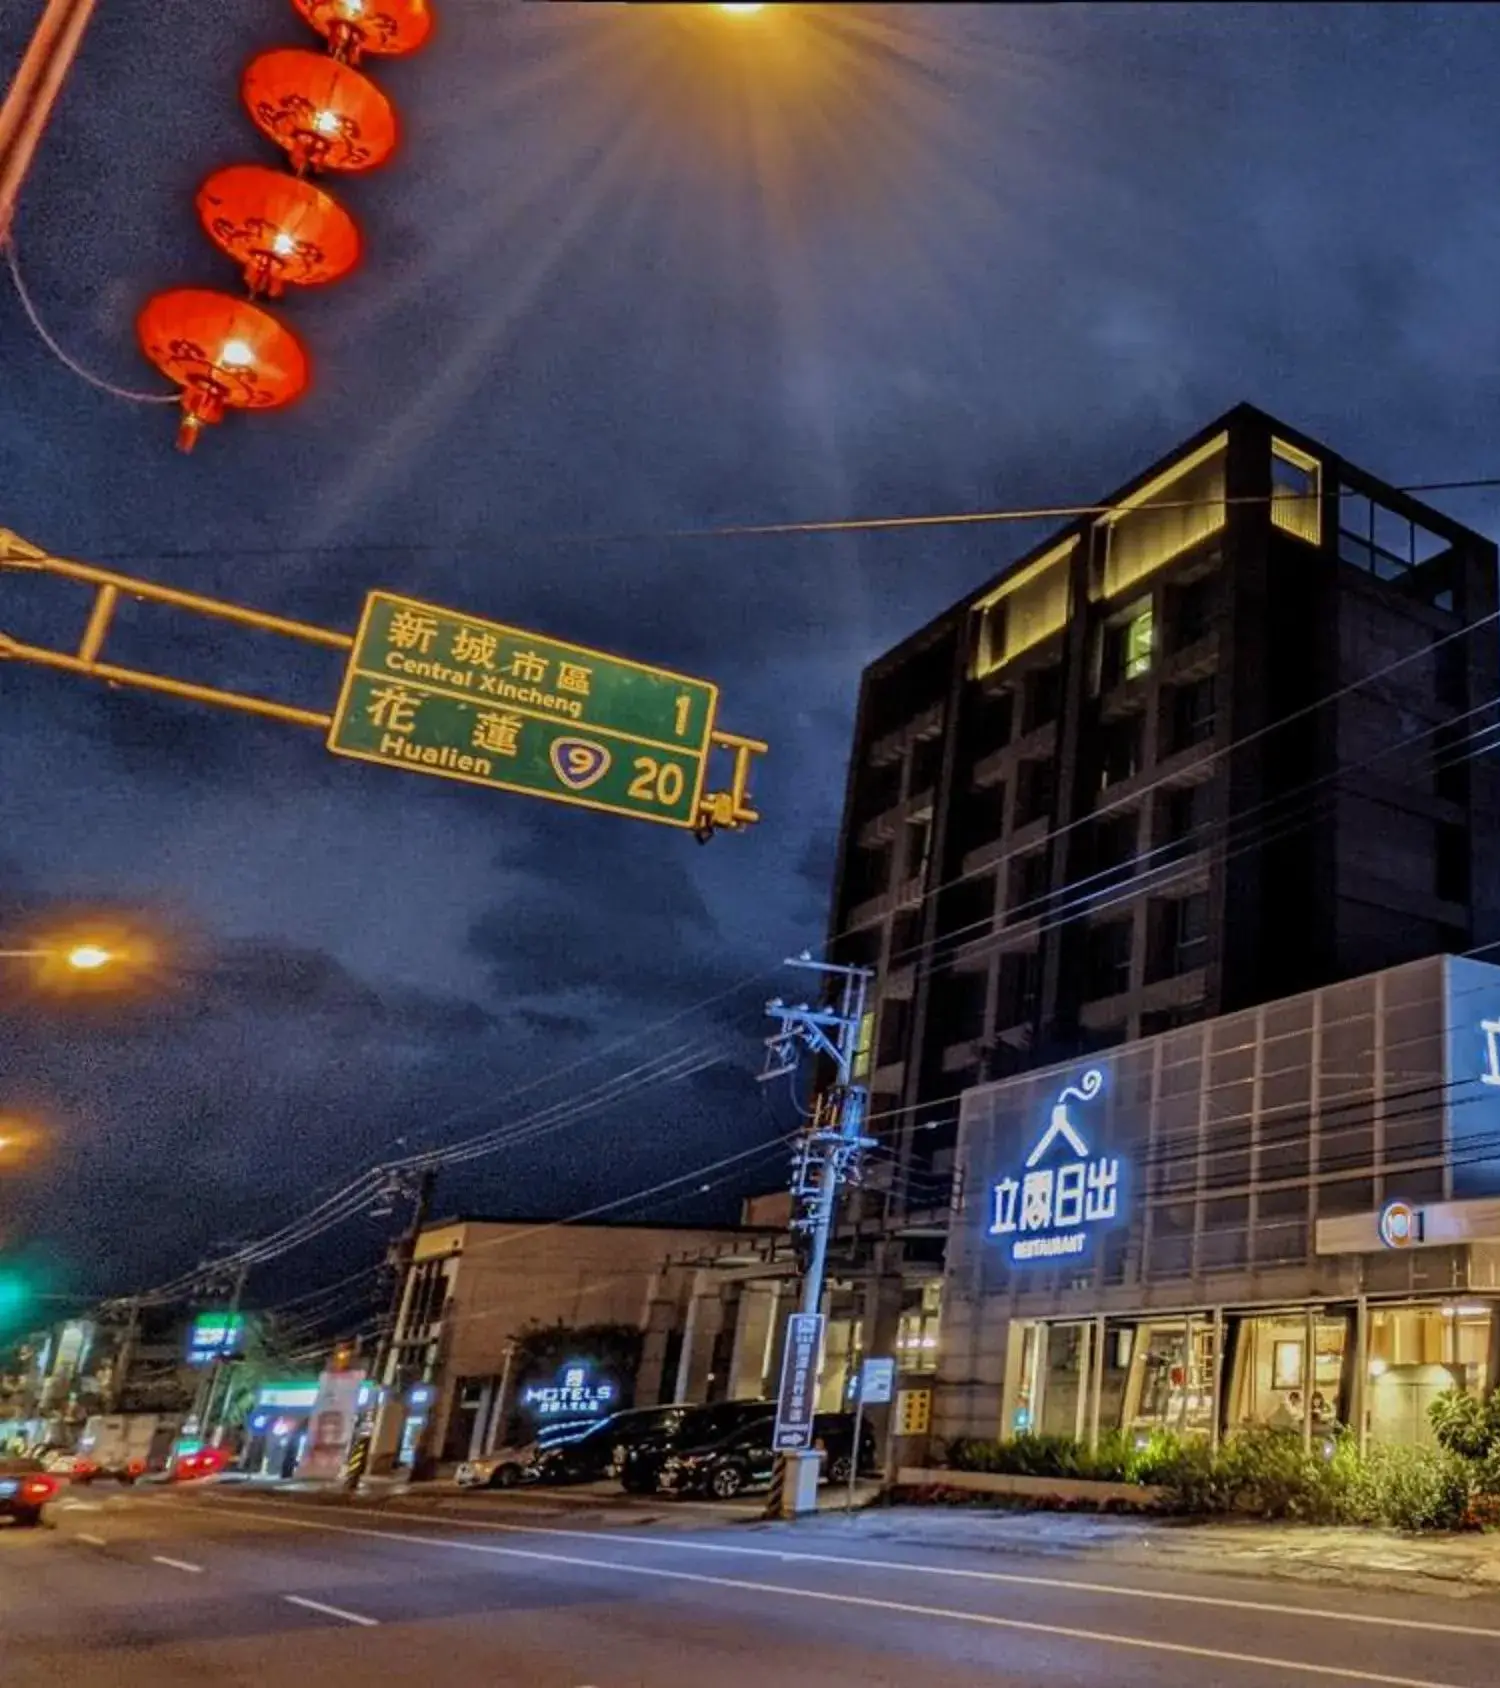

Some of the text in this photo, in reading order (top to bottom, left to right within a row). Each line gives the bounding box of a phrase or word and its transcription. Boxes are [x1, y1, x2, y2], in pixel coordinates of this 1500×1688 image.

[387, 611, 593, 696] 新城市區
[385, 651, 584, 718] Central Xincheng
[366, 685, 524, 757] 花蓮
[675, 695, 692, 736] 1
[379, 733, 492, 777] Hualien
[567, 746, 595, 775] 9
[627, 756, 685, 806] 20
